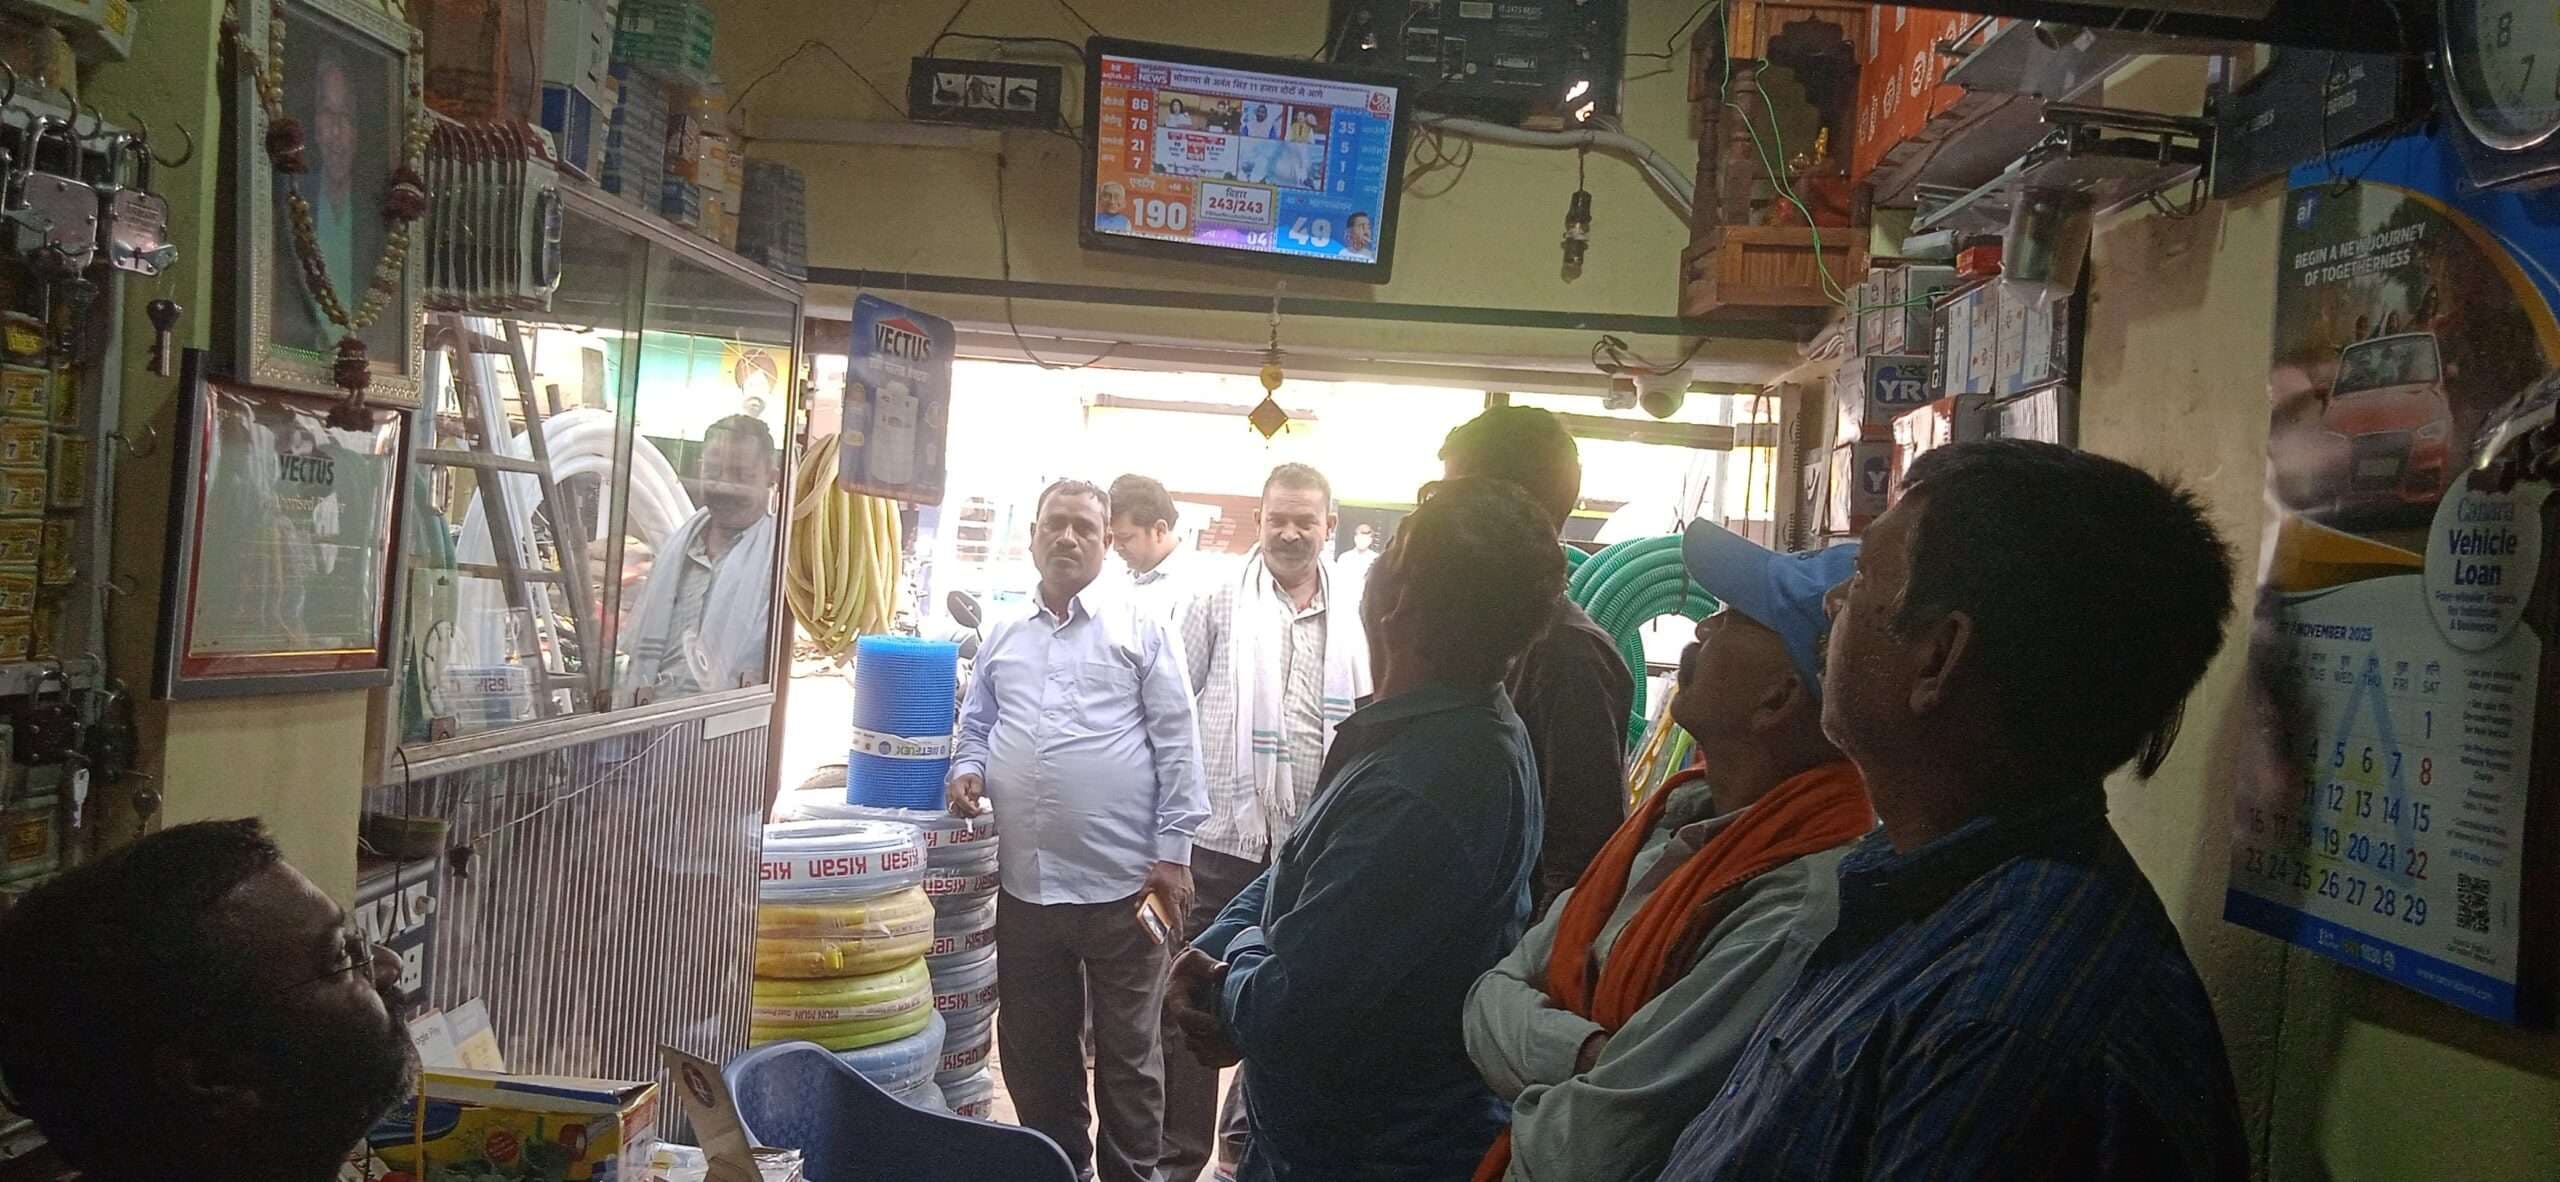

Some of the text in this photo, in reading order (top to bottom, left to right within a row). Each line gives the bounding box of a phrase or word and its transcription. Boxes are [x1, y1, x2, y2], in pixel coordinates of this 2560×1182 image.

[2497, 11, 2512, 48] 8
[1138, 72, 1168, 85] NEWS
[1250, 83, 1257, 91] 11
[2521, 54, 2535, 92] 7
[1339, 121, 1356, 134] 35
[1131, 139, 1144, 152] 21
[1133, 156, 1141, 168] 7
[1340, 160, 1346, 173] 1
[1209, 197, 1263, 214] 243/243
[1225, 188, 1247, 199] बिहार
[1132, 198, 1187, 231] 190
[1288, 216, 1332, 247] 49
[2295, 222, 2427, 270] BEGIN A NEW JOURNEY
[2304, 249, 2412, 287] OF TOGETHERNESS
[875, 323, 932, 361] VECTUS
[280, 455, 334, 486] VECTUS
[2448, 528, 2518, 555] Vehicle
[2454, 560, 2501, 585] Loan
[2348, 627, 2373, 642] 2025
[2393, 677, 2409, 691] FRI
[2423, 680, 2441, 694] SAT
[2424, 710, 2432, 739] 1
[2334, 742, 2345, 768] 5
[2363, 747, 2372, 773] 6
[2392, 752, 2402, 777] 7
[2420, 757, 2432, 785] 8
[2328, 784, 2343, 811] 12
[2356, 790, 2372, 818] 13
[2384, 797, 2399, 824] 14
[2413, 802, 2431, 832] 15
[2323, 826, 2340, 855] 19
[2347, 833, 2370, 863] 20
[2377, 841, 2396, 872] 21
[2404, 848, 2428, 880] 22
[2246, 847, 2427, 926] 23 24 25 26 27 28 29
